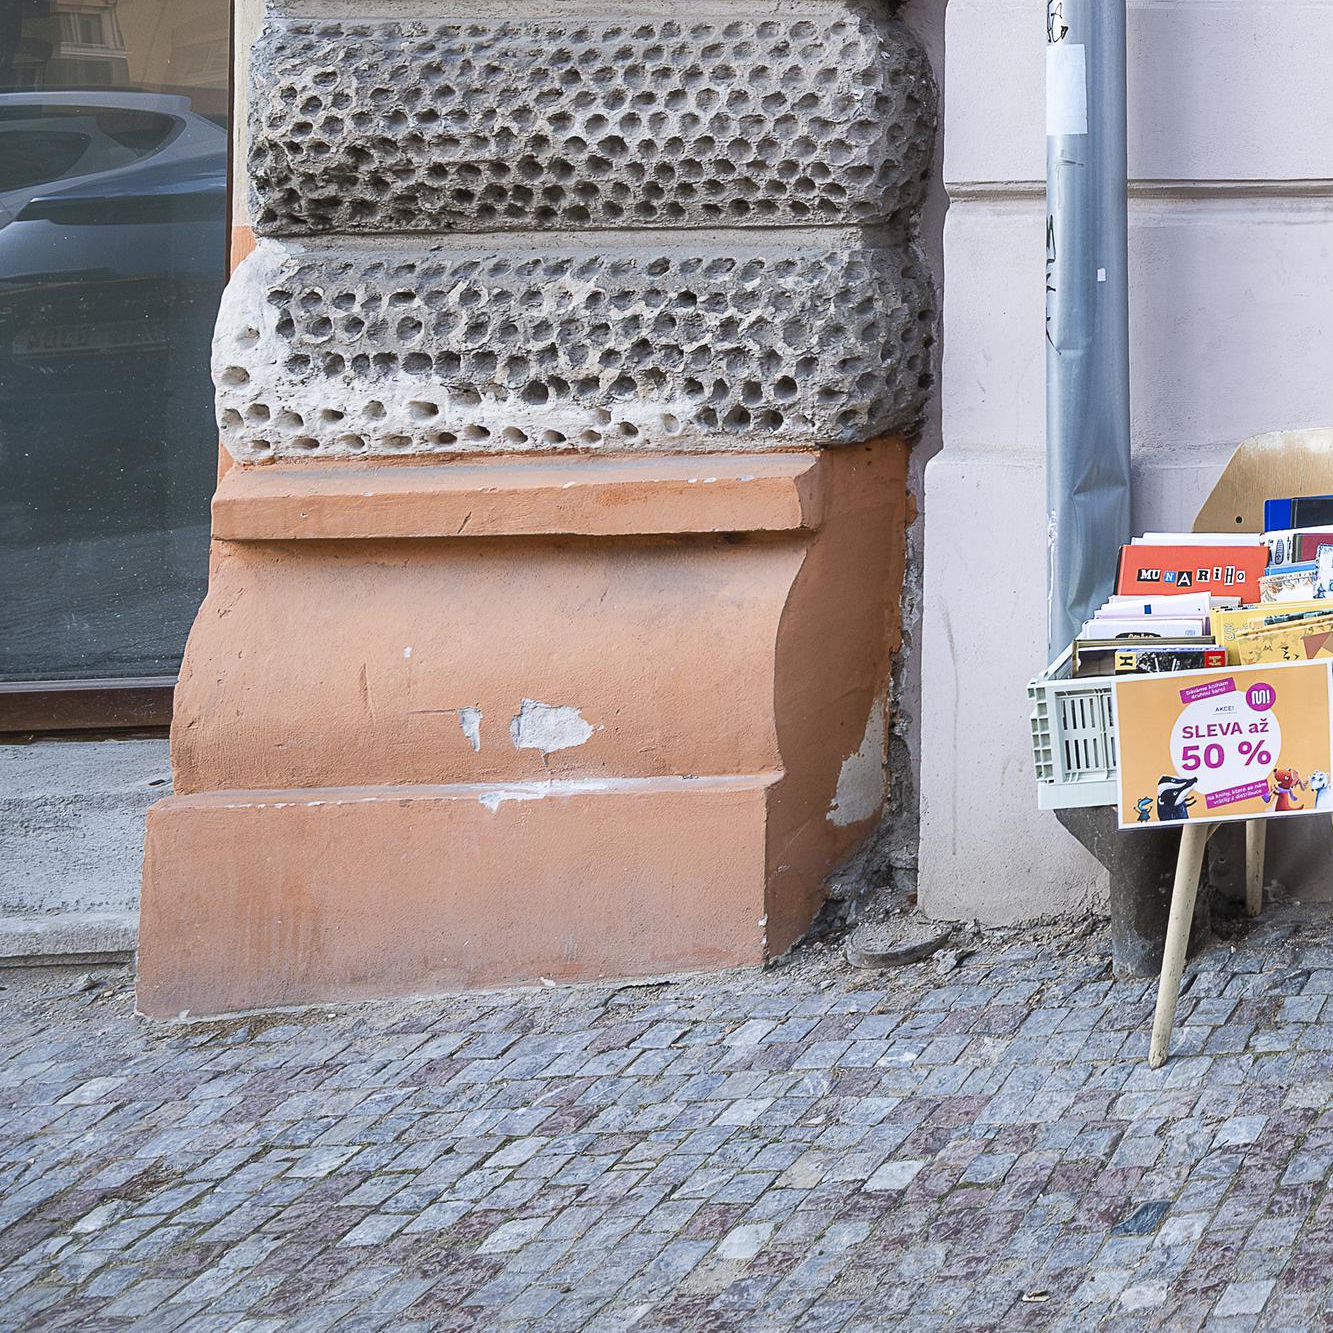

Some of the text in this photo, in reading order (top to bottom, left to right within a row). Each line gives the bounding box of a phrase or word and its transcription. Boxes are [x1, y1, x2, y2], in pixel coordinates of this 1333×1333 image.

[1181, 717, 1270, 739] SLEVA až
[1181, 739, 1272, 771] 50 %
